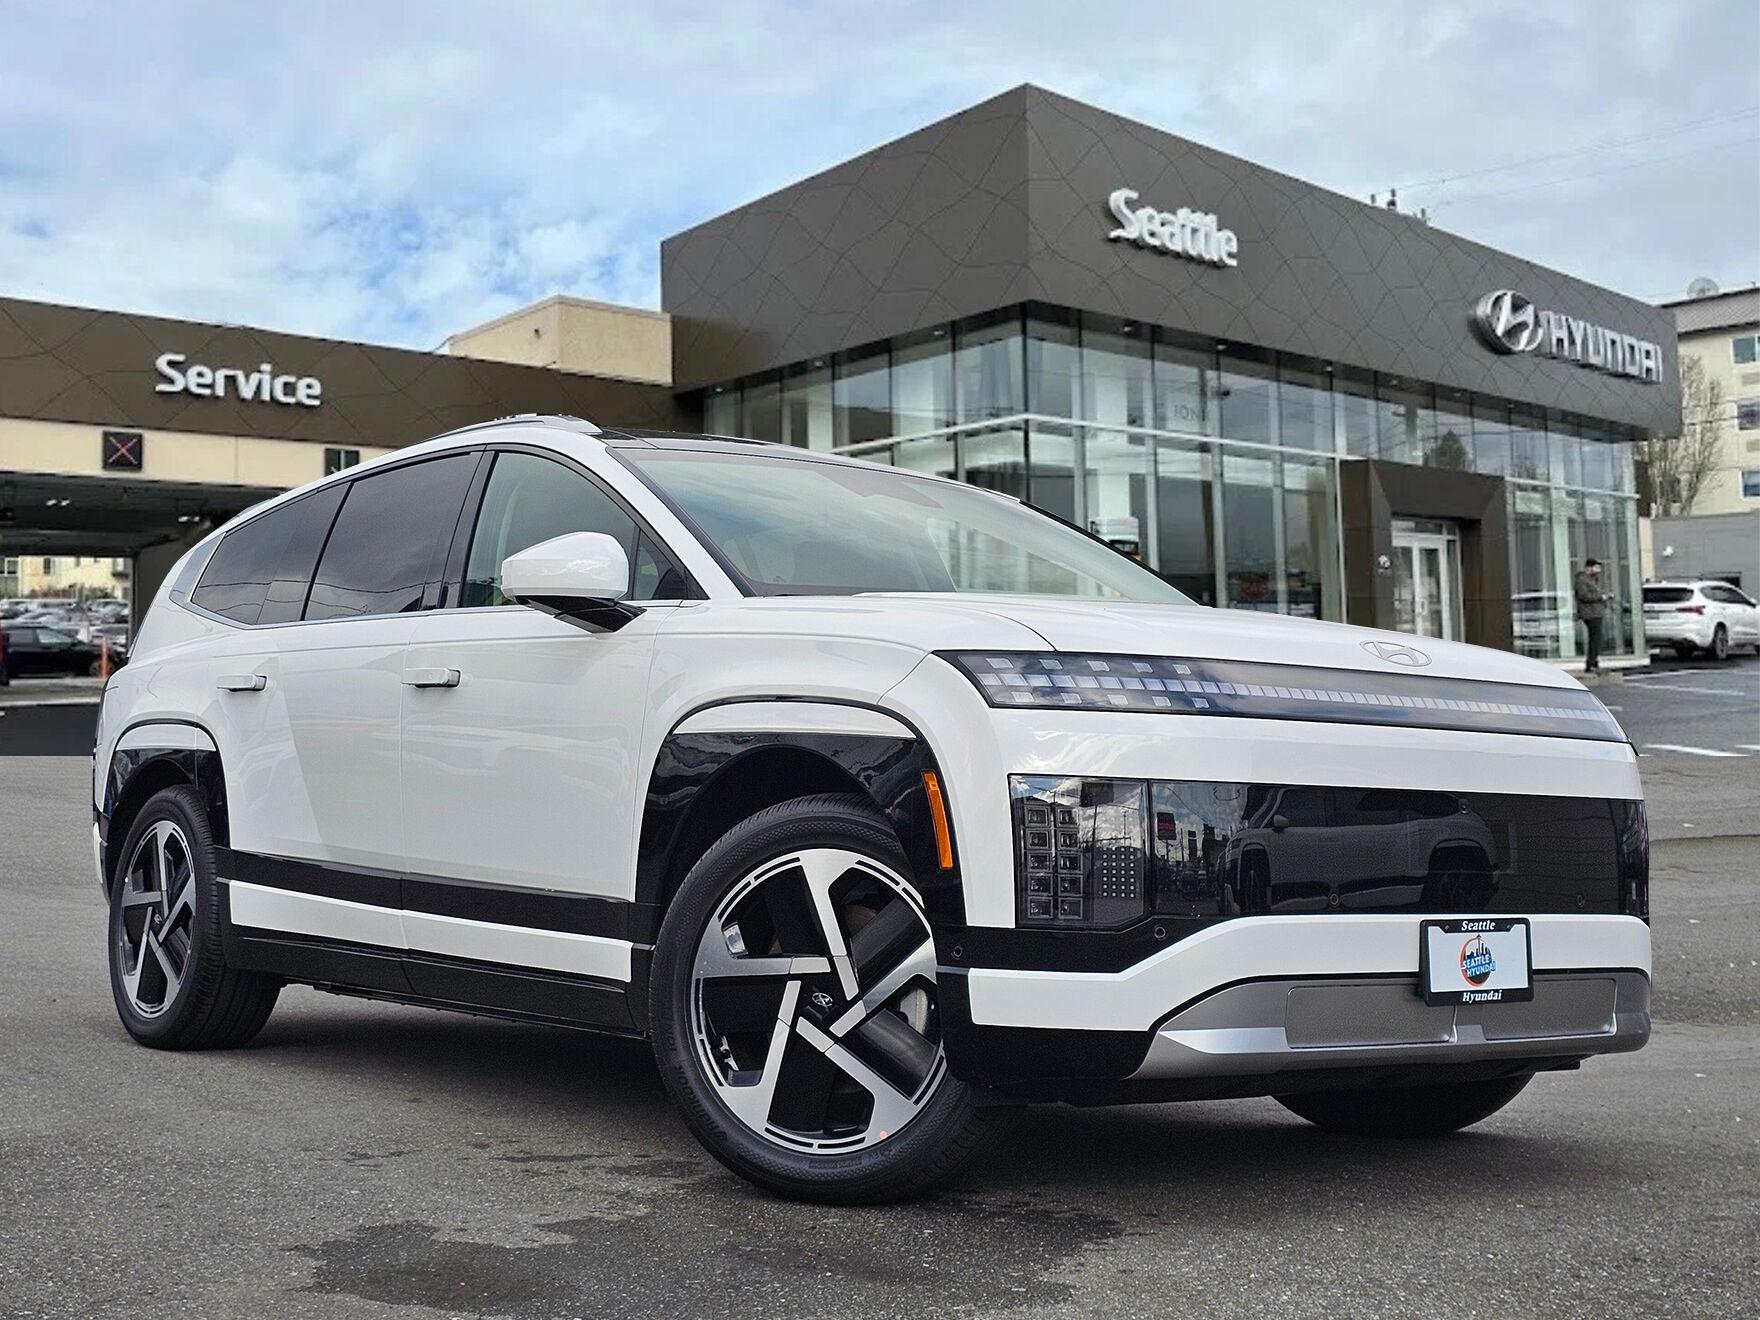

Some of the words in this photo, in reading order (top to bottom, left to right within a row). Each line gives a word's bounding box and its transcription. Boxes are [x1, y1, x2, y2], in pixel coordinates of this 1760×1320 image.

[1108, 187, 1238, 267] Seattle
[1541, 311, 1663, 383] HYUNDAI
[155, 353, 322, 406] Service
[1461, 920, 1496, 931] Seattle
[1462, 954, 1490, 969] SEATTLE
[1466, 961, 1495, 977] HYUNDAI
[1462, 990, 1502, 1003] Hyundai
